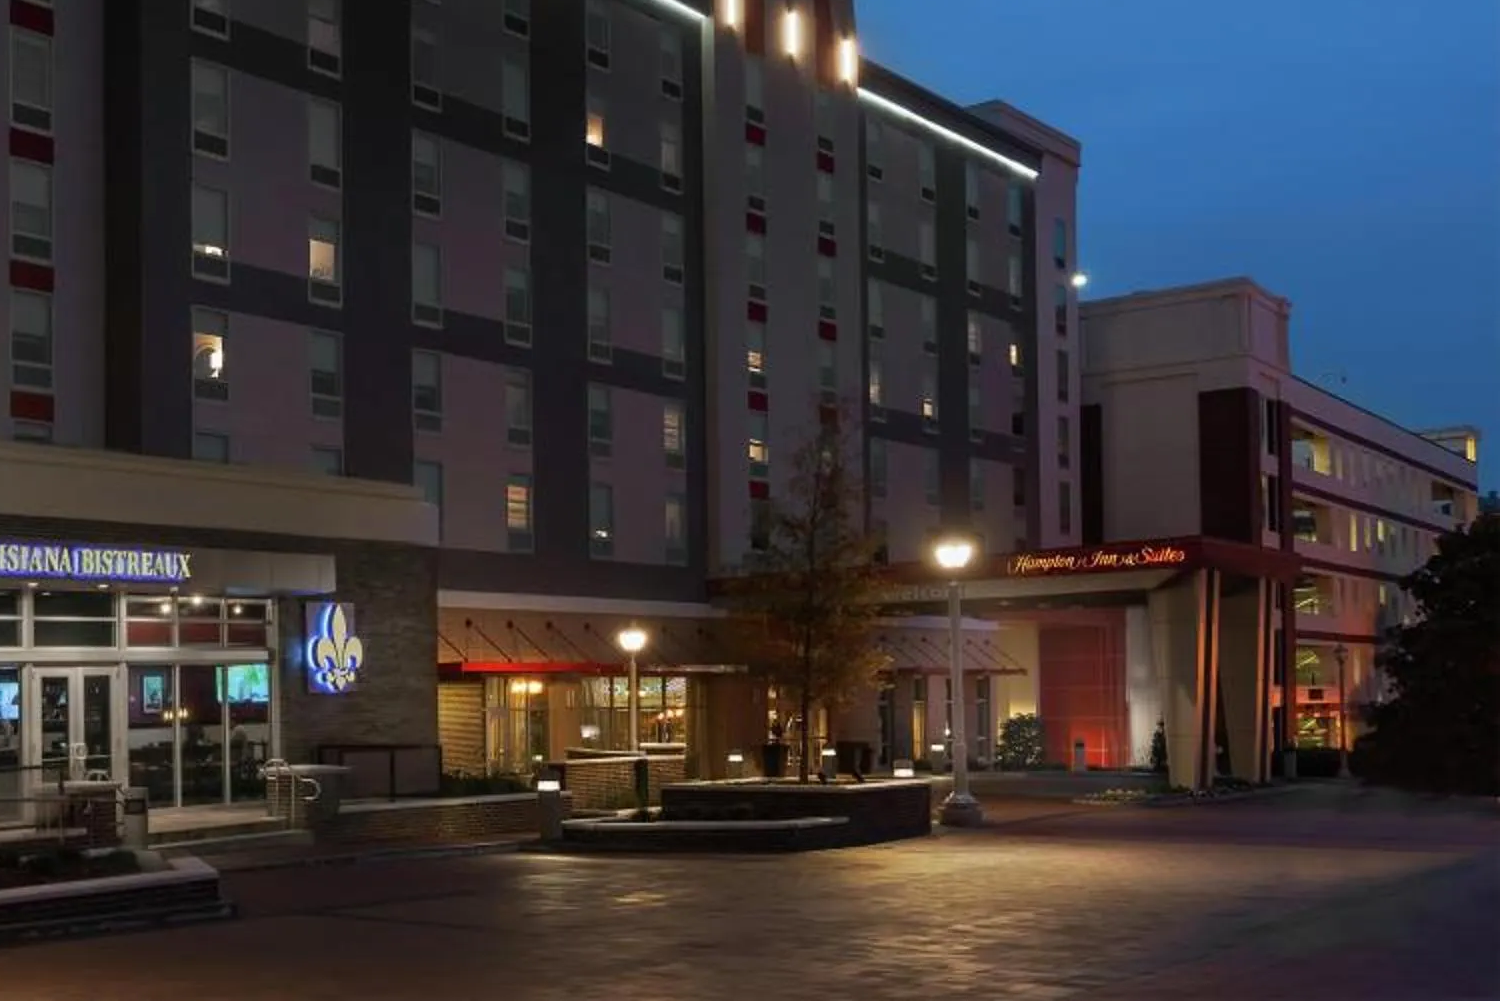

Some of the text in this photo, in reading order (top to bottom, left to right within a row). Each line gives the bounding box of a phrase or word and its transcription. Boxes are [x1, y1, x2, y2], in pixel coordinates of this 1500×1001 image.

[77, 549, 191, 579] BISTREAUX
[1007, 553, 1086, 574] Hampton
[1085, 551, 1124, 569] Inn
[1136, 546, 1185, 565] Suites
